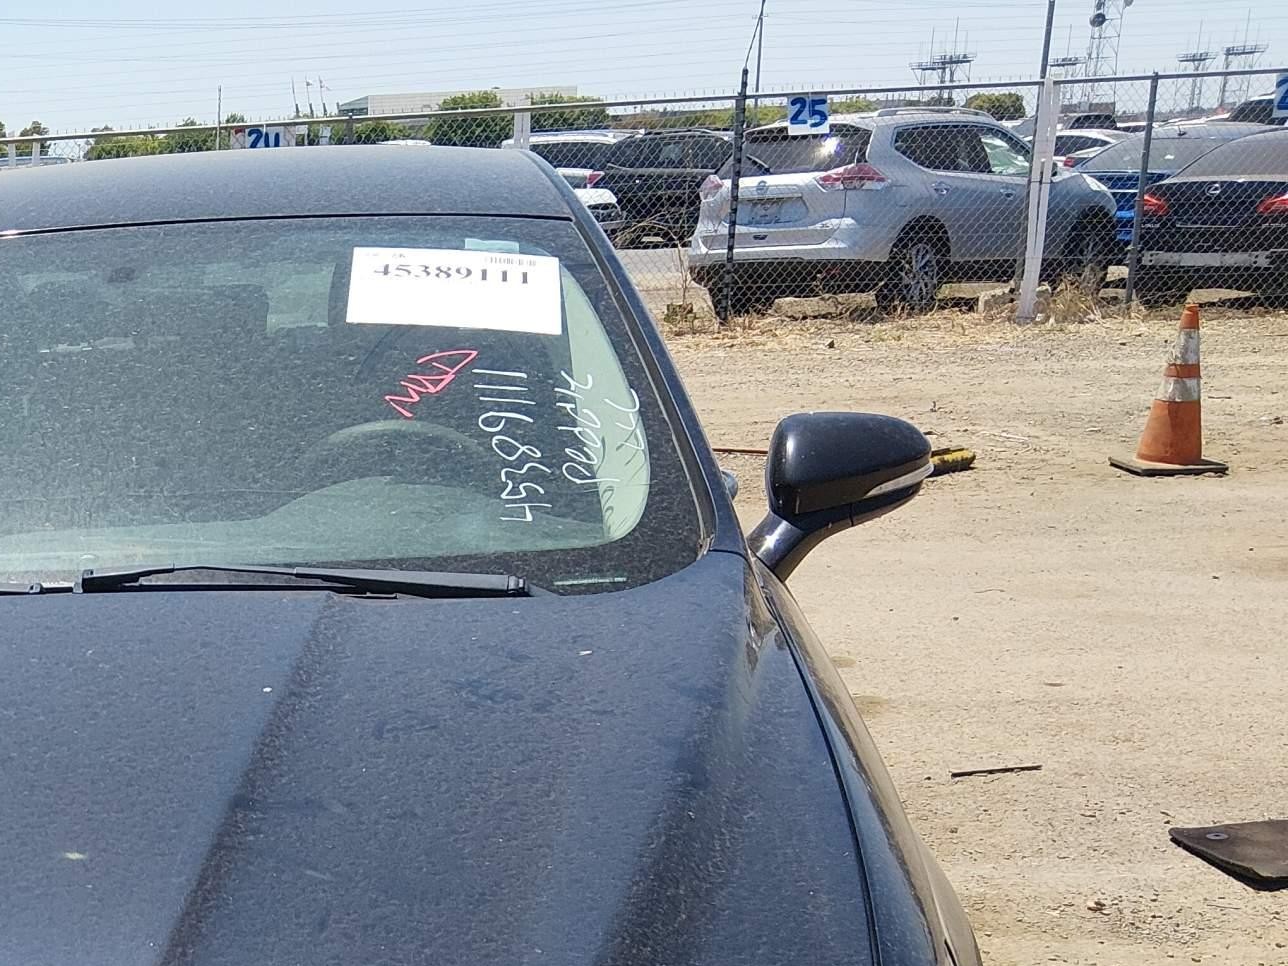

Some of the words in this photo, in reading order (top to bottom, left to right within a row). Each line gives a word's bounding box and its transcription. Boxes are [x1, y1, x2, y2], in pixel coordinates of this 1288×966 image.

[789, 97, 829, 128] 25
[373, 263, 529, 284] 45389111
[471, 368, 553, 522] 45389111
